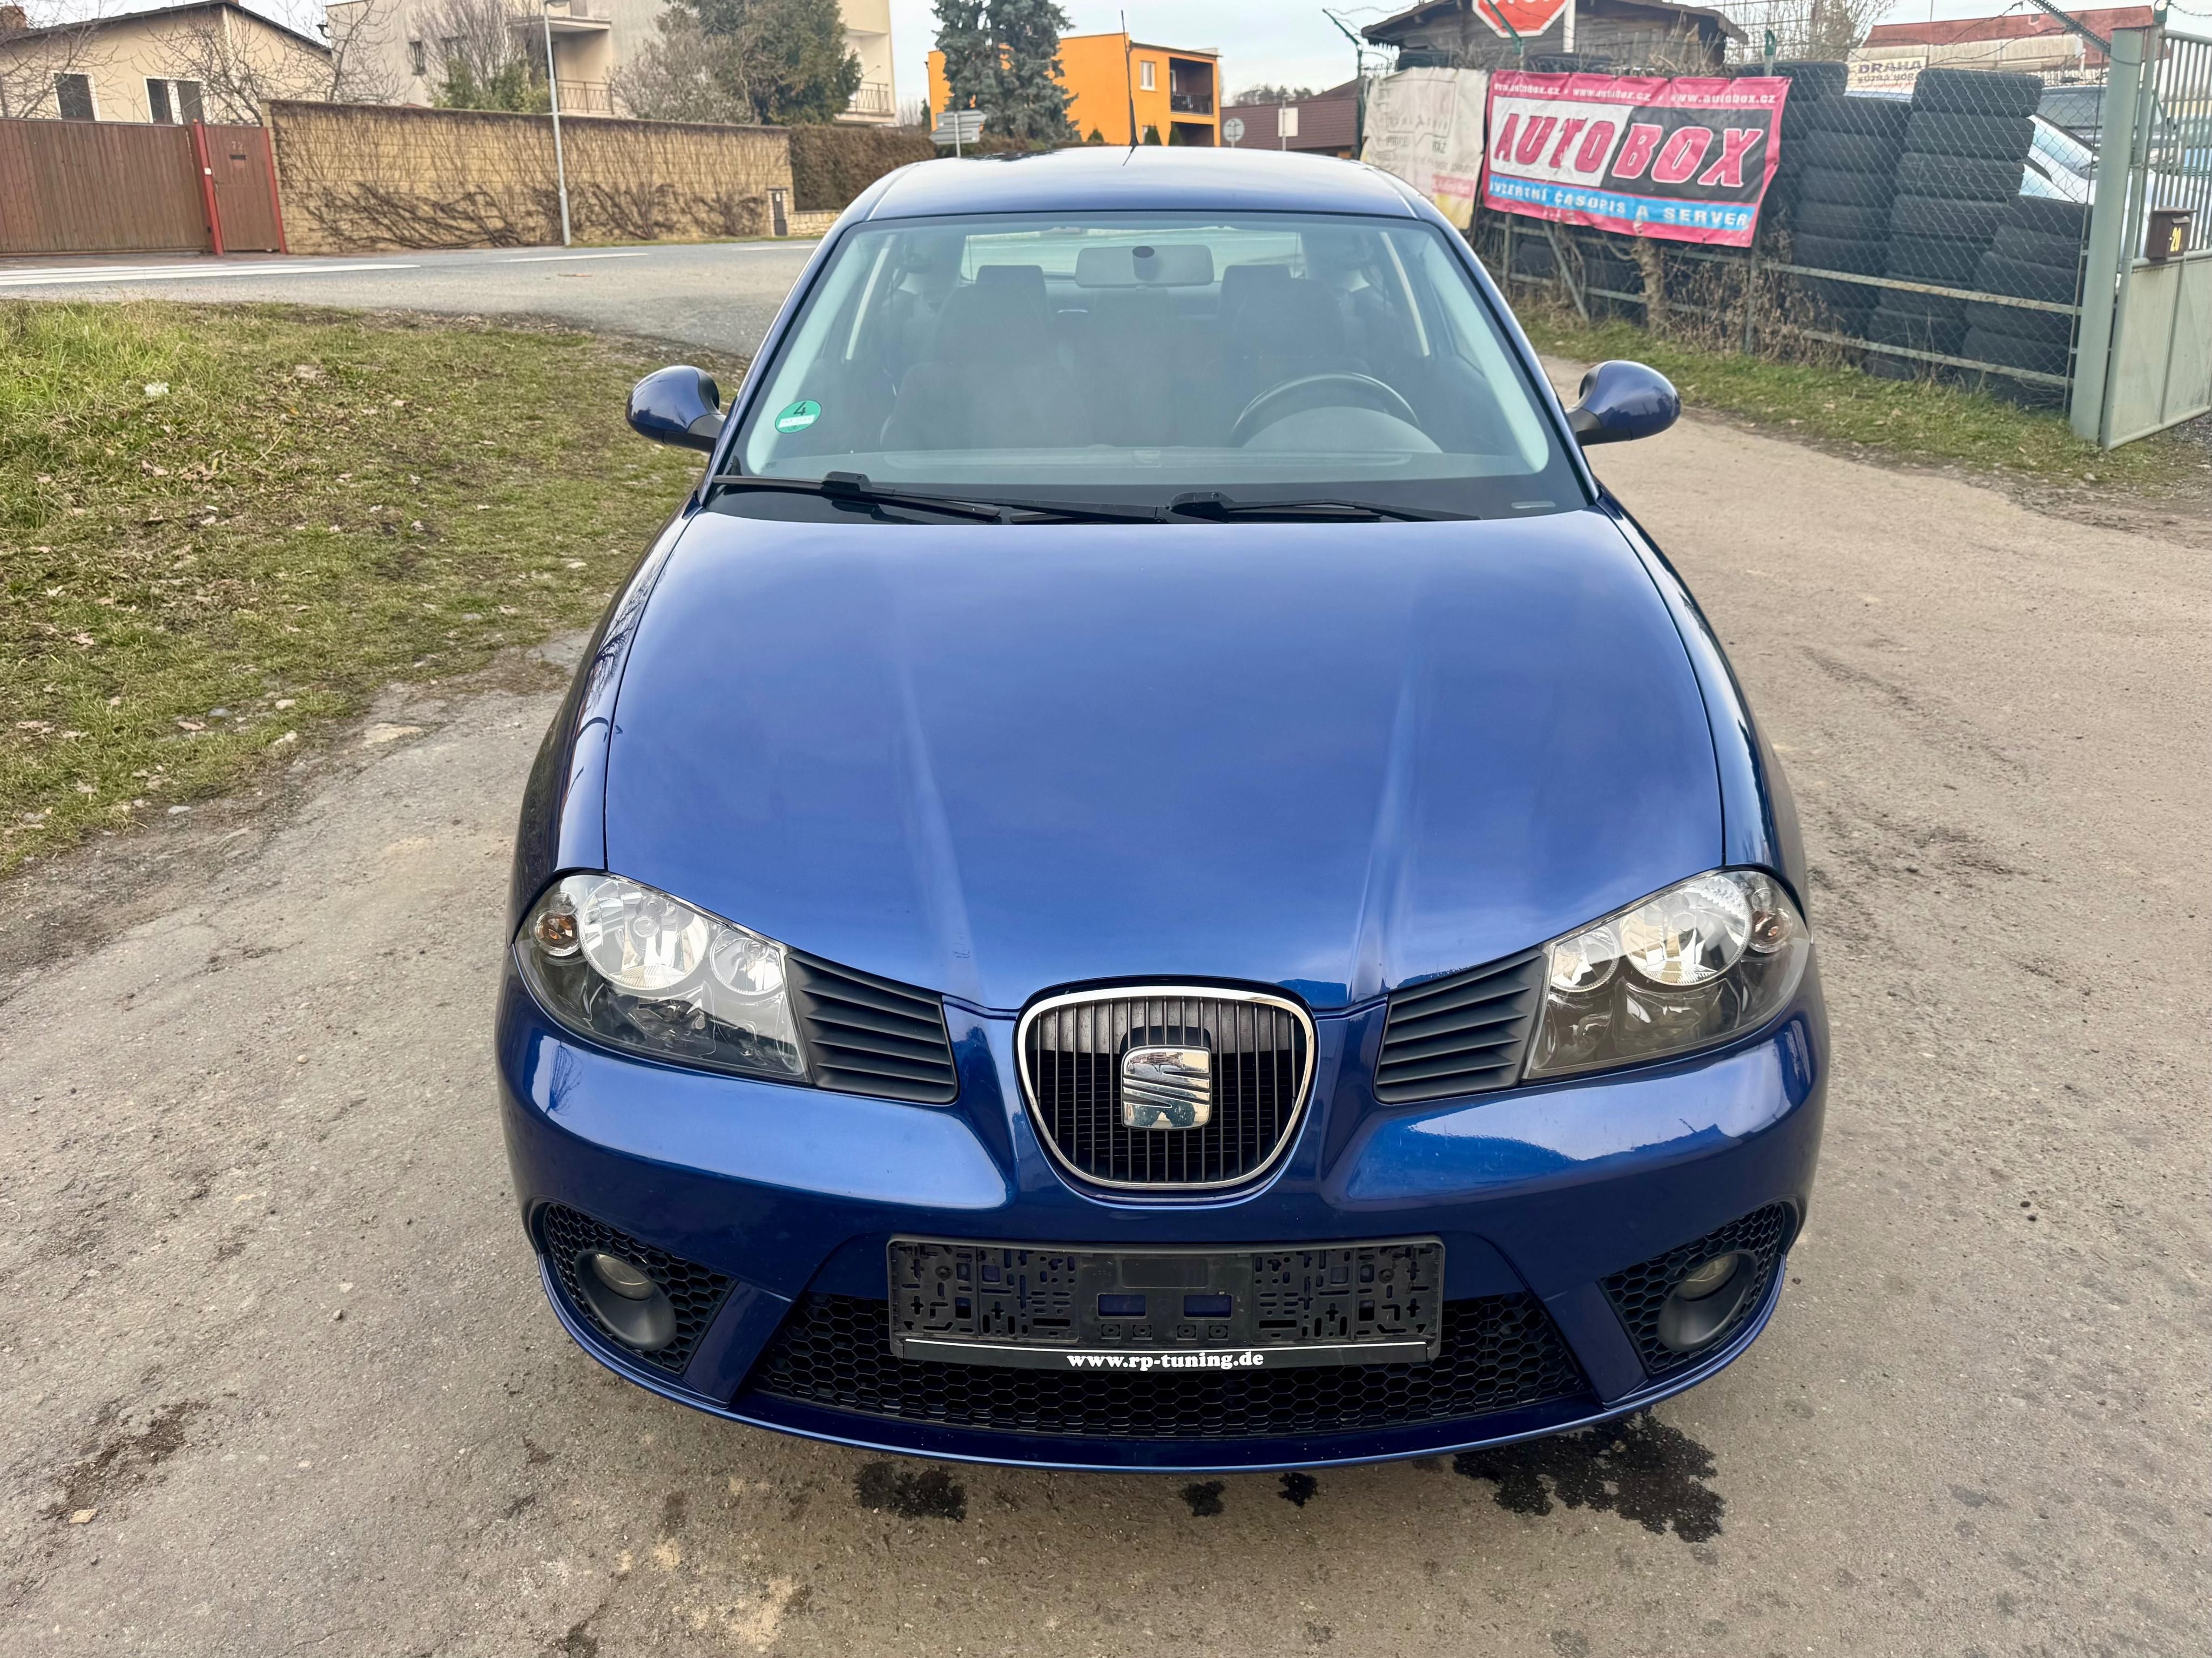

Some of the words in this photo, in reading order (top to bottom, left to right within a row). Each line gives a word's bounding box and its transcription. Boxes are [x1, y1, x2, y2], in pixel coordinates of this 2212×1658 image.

[1554, 189, 1626, 214] ČASOPIS
[1636, 205, 1649, 218] A
[1663, 206, 1748, 226] SERVER
[2170, 227, 2181, 252] 20
[793, 401, 807, 416] 4
[1067, 1351, 1264, 1371] www.rp-tuning.de
